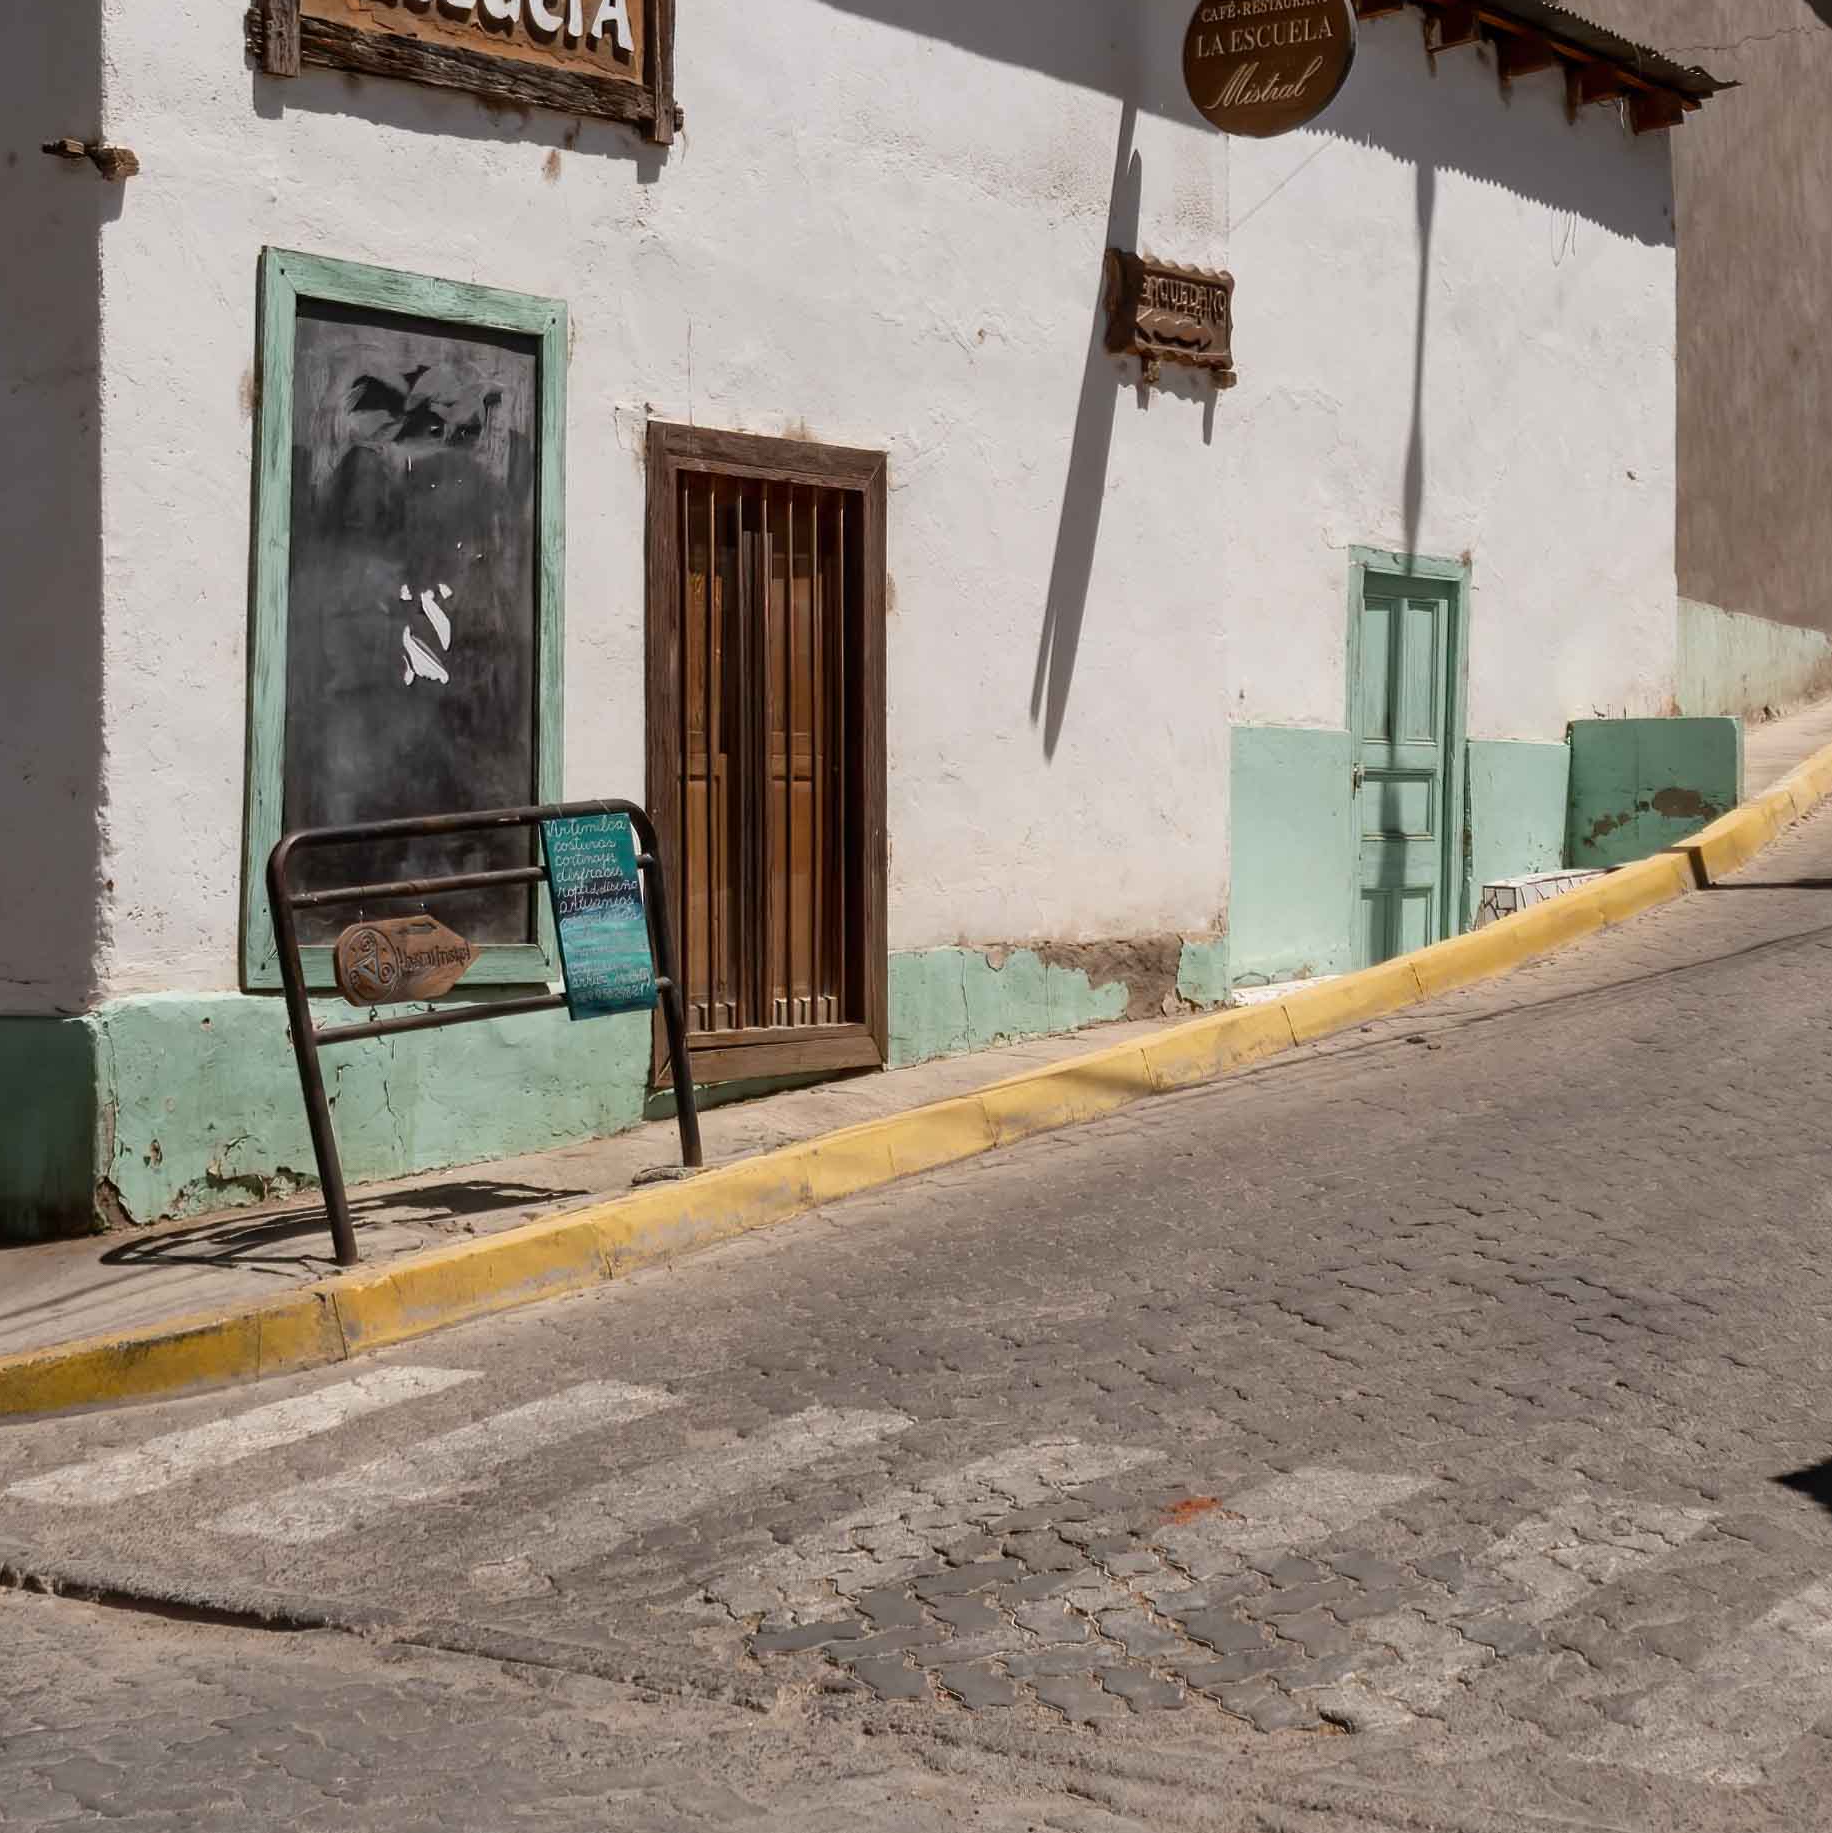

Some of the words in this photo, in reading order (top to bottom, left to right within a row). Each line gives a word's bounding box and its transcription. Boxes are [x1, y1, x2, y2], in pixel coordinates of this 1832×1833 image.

[1196, 31, 1226, 58] LA
[1230, 16, 1335, 53] ESCUELA
[1203, 55, 1324, 110] Mistral
